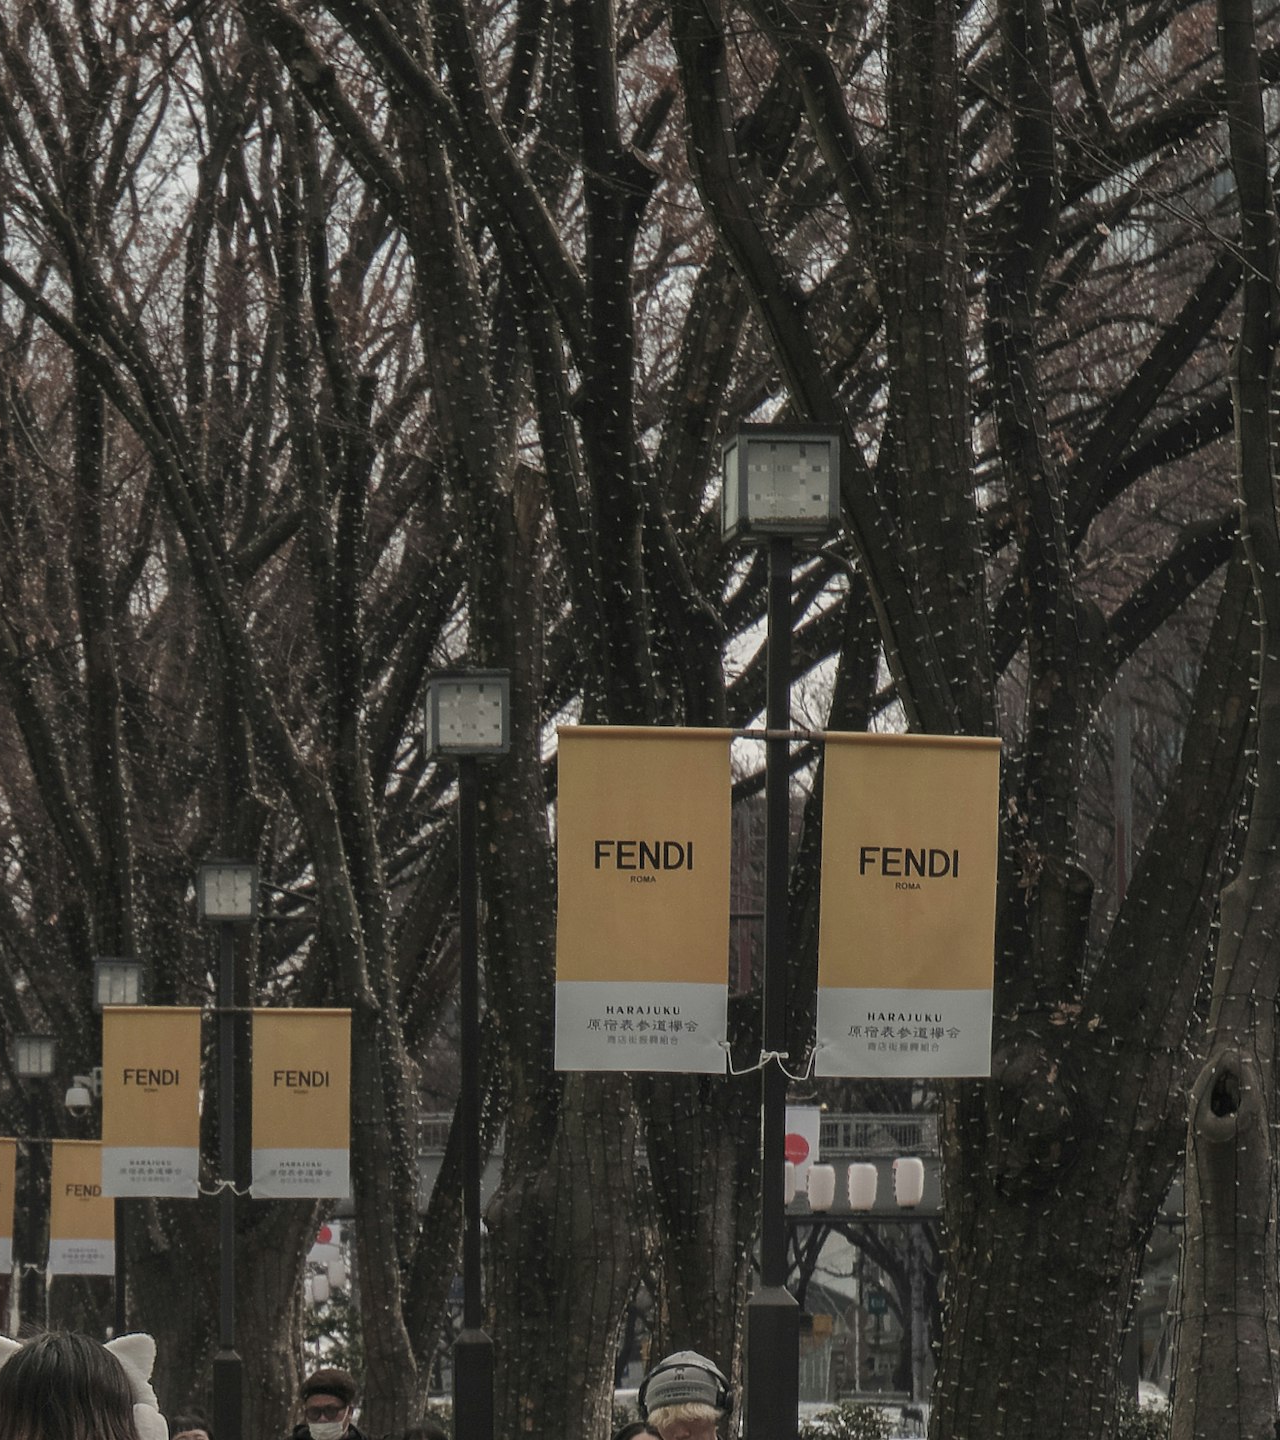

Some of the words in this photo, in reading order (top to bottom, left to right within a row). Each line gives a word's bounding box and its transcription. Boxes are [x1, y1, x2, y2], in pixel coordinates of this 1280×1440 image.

[594, 840, 693, 871] FENDI
[859, 846, 959, 878] FENDI
[629, 875, 657, 884] ROMA
[895, 882, 921, 891] ROMA
[606, 1005, 681, 1016] HARAJUKU
[867, 1012, 942, 1023] HARAJUKU
[123, 1068, 179, 1086] FENDI
[273, 1070, 329, 1088] FENDI
[66, 1184, 102, 1197] FEND
